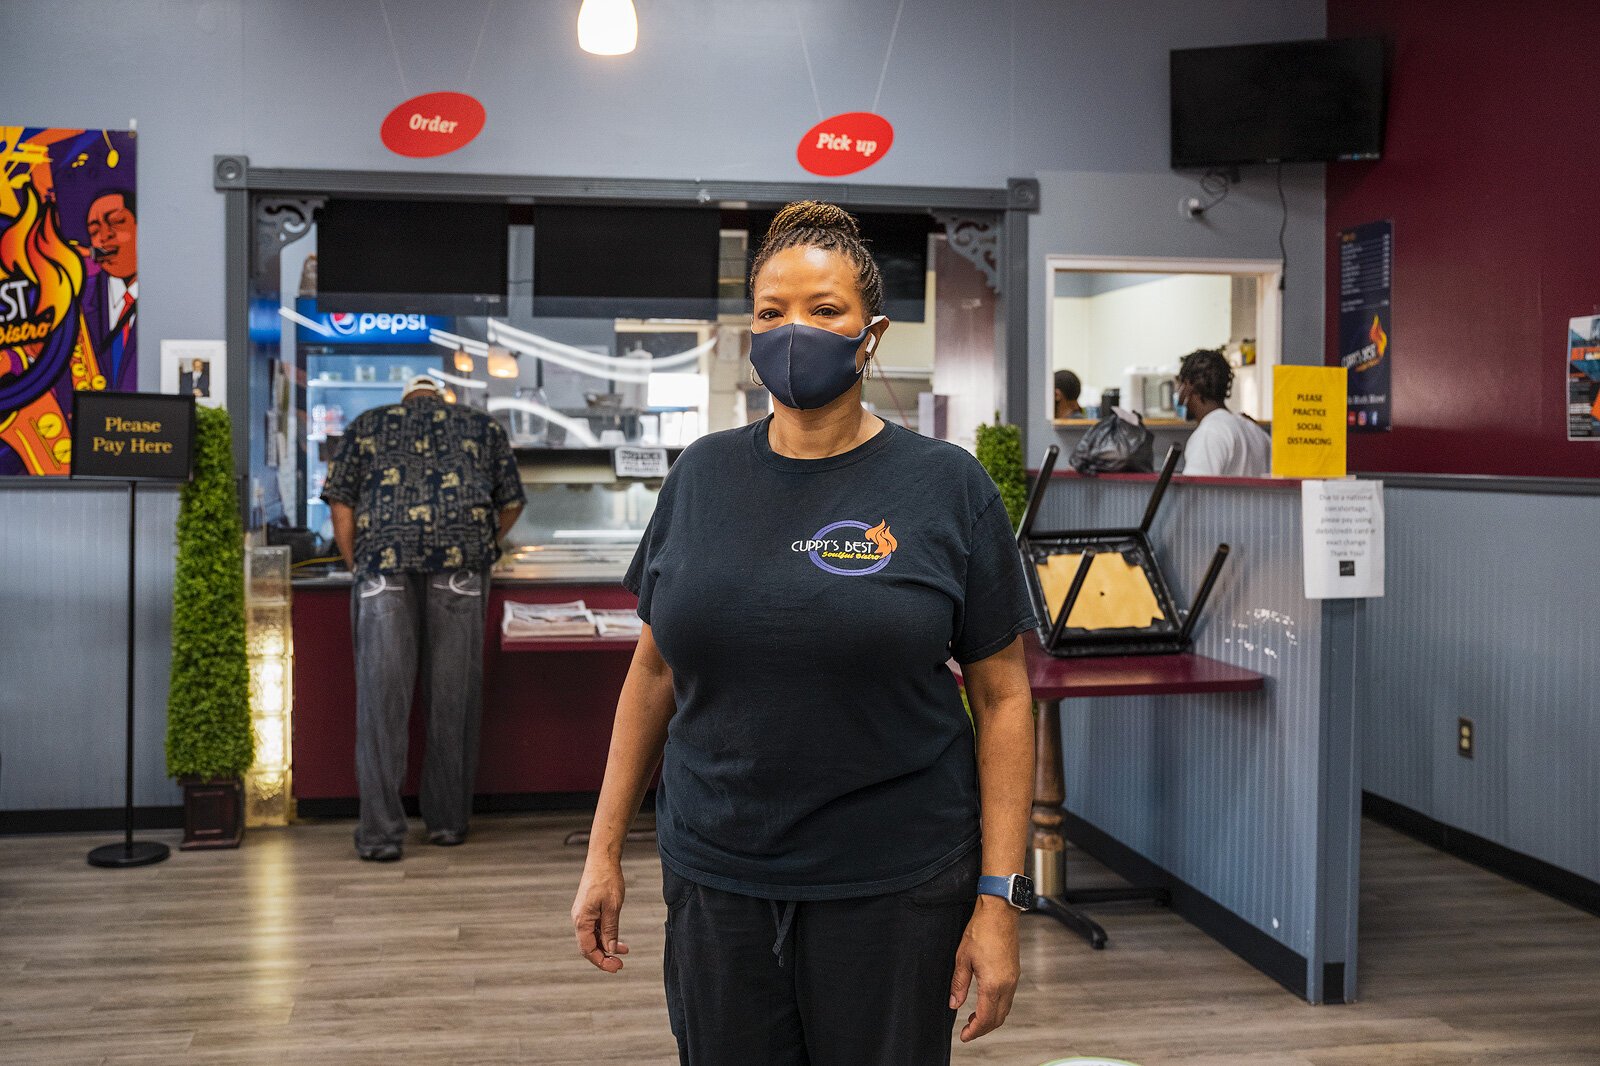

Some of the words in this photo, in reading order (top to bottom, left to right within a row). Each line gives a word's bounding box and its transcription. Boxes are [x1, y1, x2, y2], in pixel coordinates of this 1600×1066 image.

[409, 113, 458, 134] Order
[816, 132, 853, 151] Pick
[855, 139, 877, 157] up
[359, 312, 427, 335] pepsi
[1297, 393, 1323, 402] PLEASE
[1292, 407, 1327, 417] PRACTICE
[105, 416, 162, 433] Please
[1297, 422, 1323, 431] SOCIAL
[92, 436, 125, 457] Pay
[130, 437, 173, 454] Here
[1287, 436, 1333, 446] DISTANCING
[791, 540, 839, 552] CUPPY'S
[844, 541, 875, 554] BEST
[821, 551, 854, 559] Soulful
[855, 553, 882, 561] Bistro
